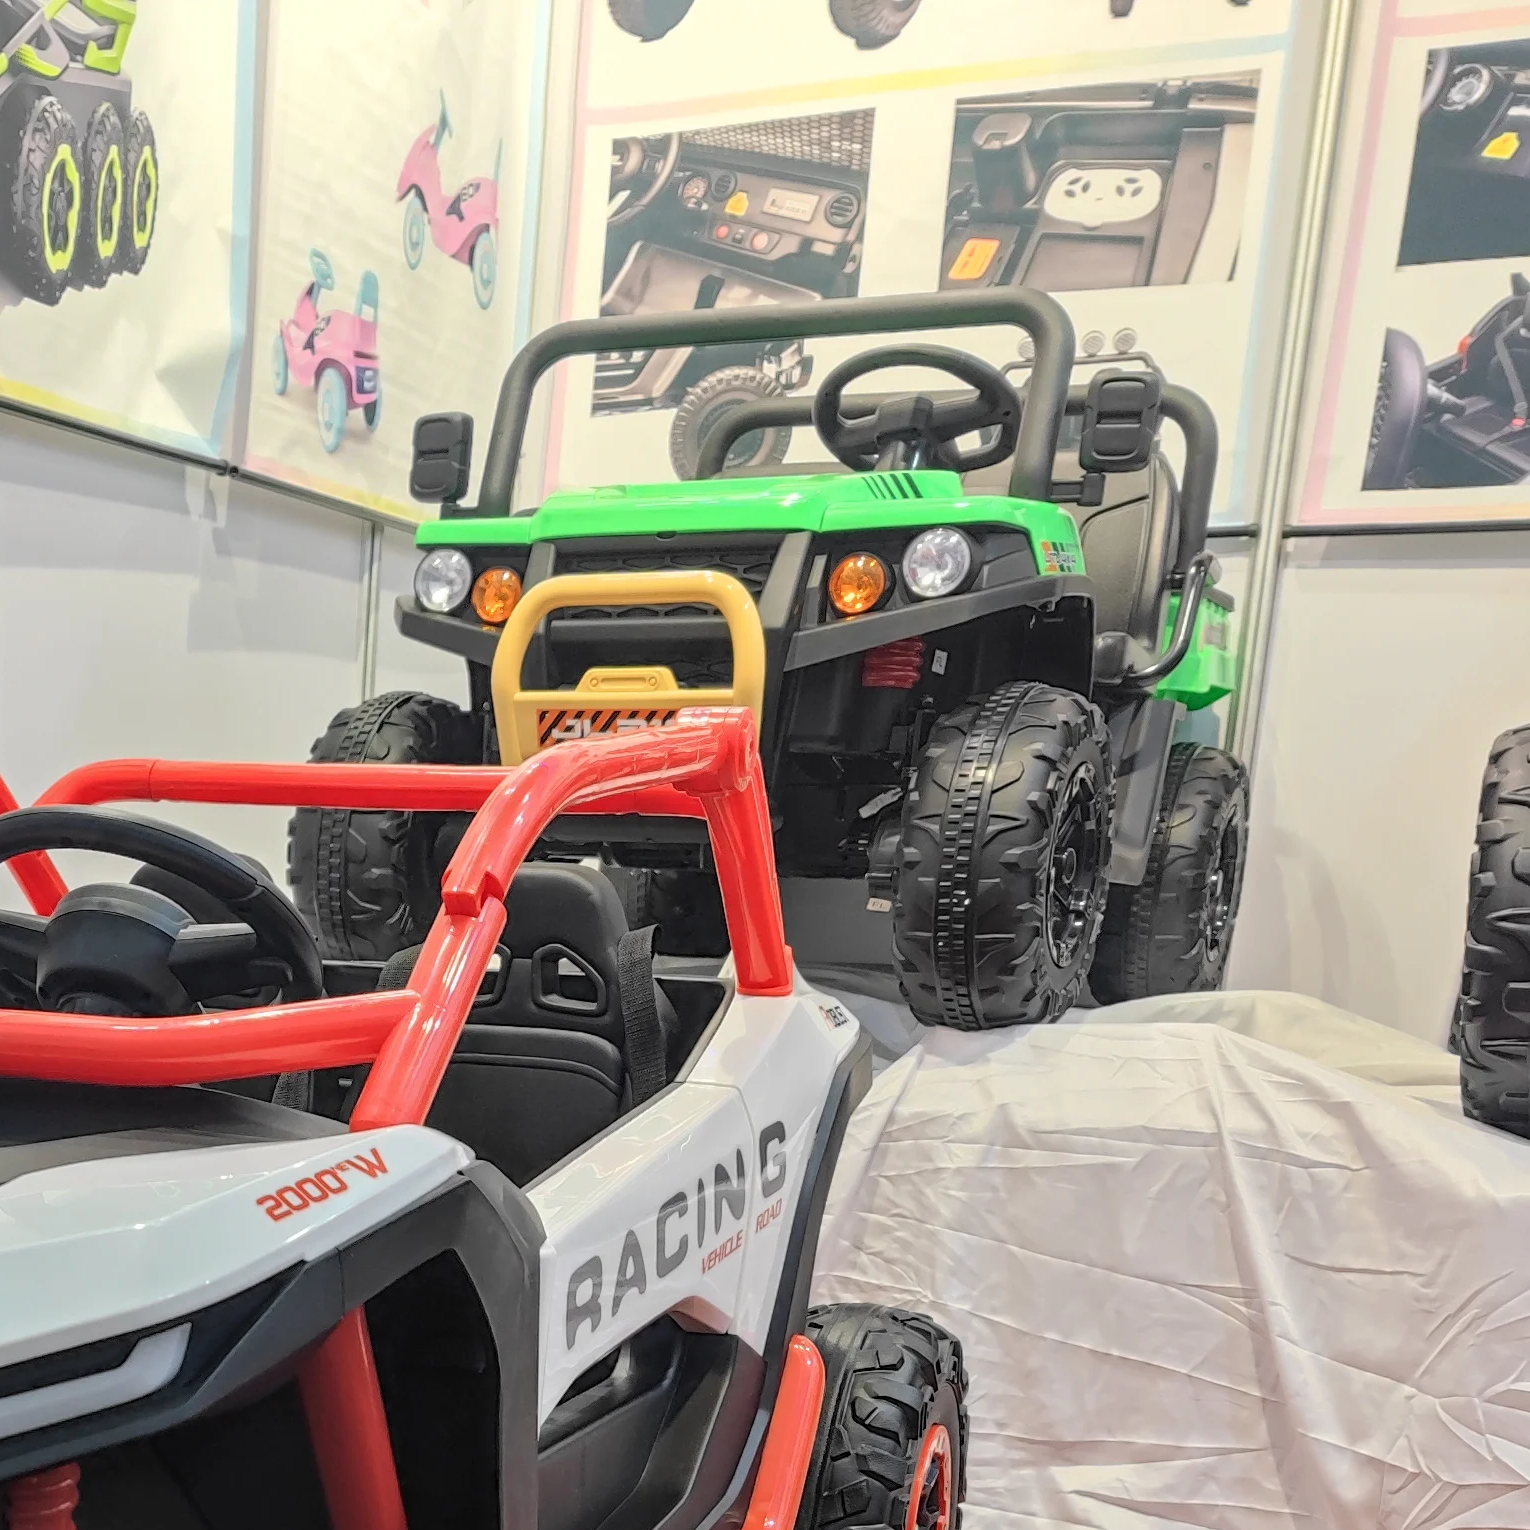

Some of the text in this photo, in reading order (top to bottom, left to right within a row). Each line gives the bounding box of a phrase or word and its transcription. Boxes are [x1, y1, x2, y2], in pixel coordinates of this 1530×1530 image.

[565, 1120, 786, 1350] RACING
[701, 1198, 783, 1274] VEHICLE ROAD
